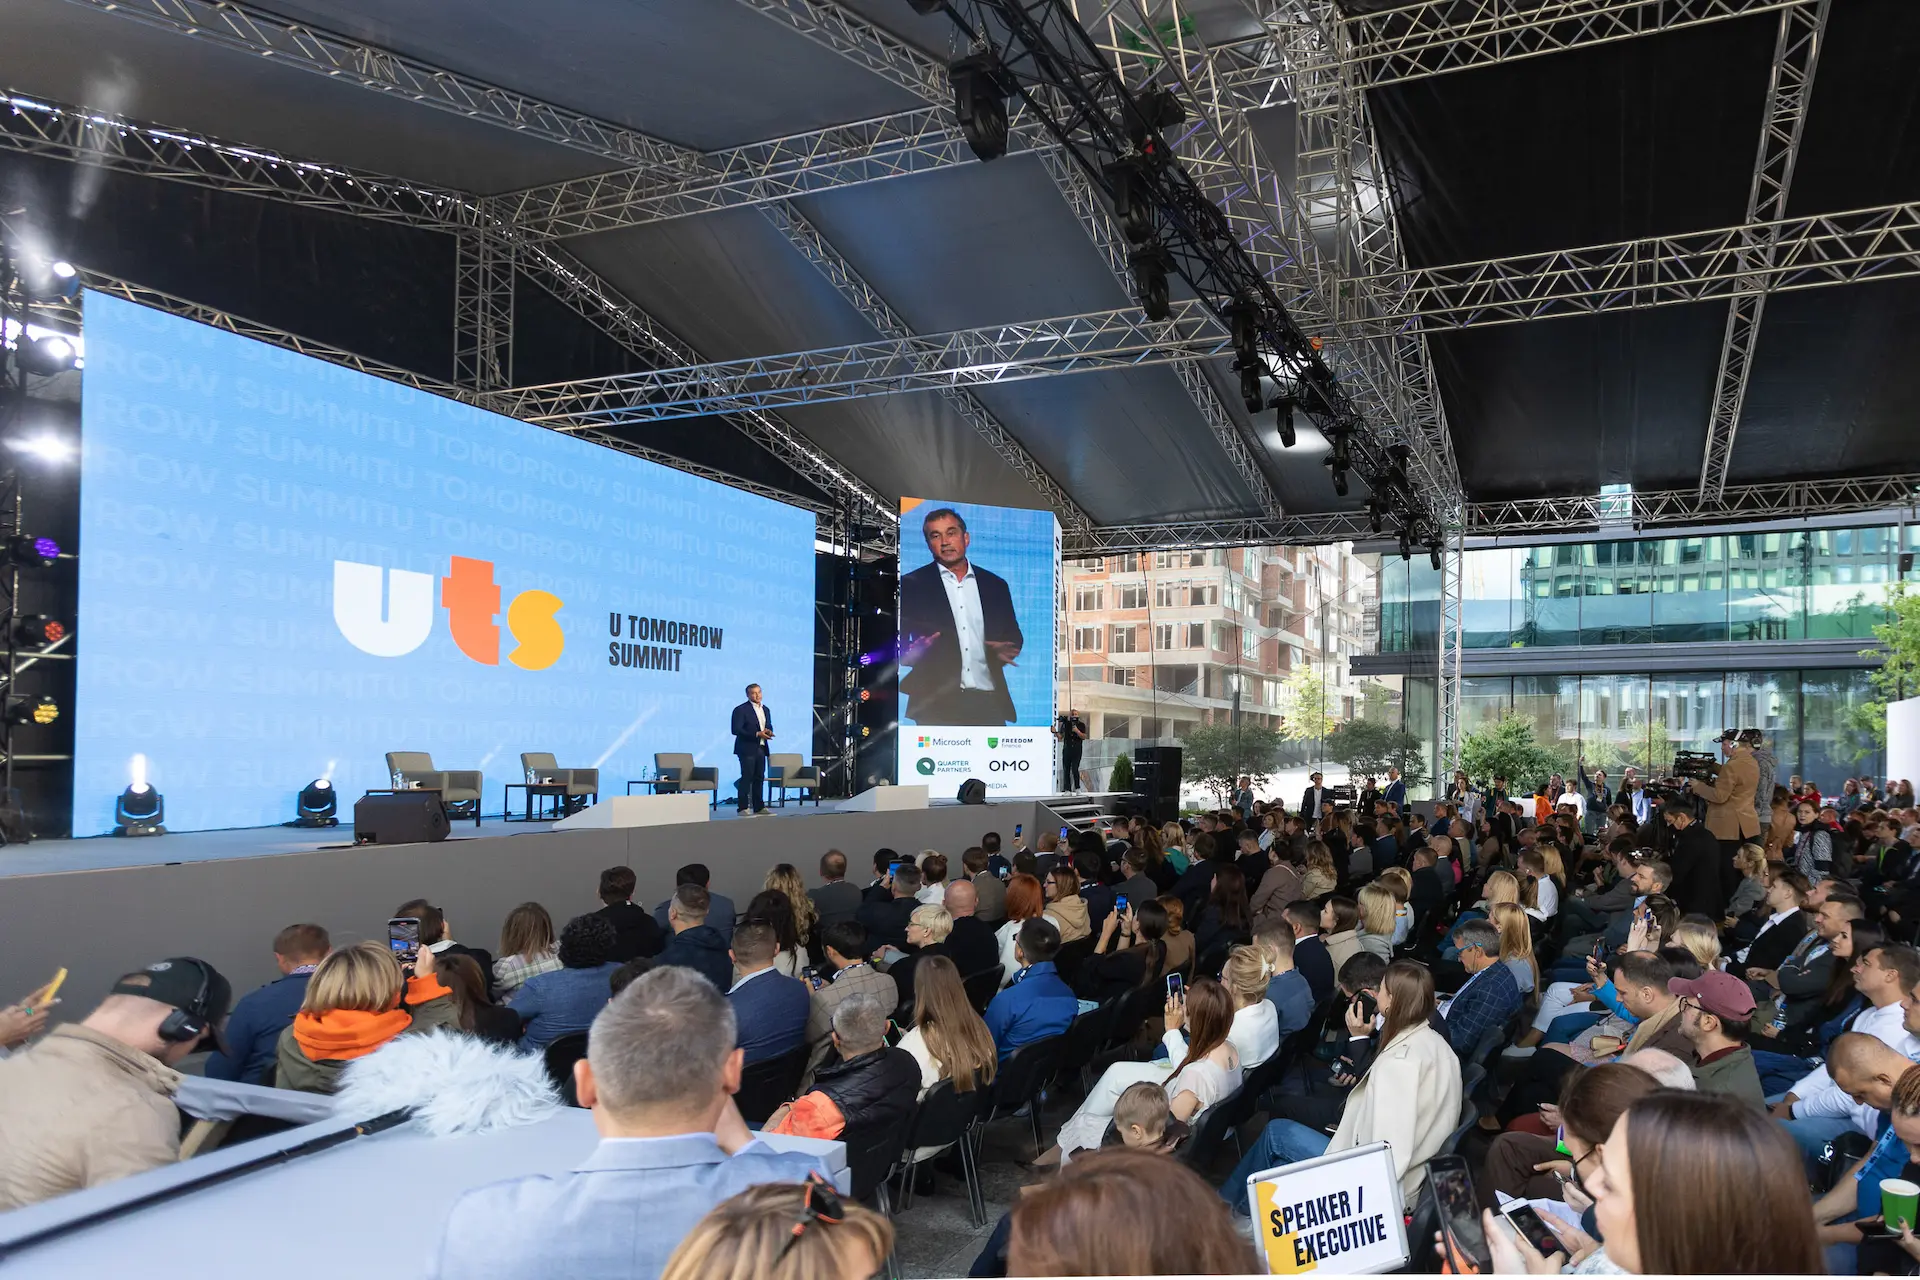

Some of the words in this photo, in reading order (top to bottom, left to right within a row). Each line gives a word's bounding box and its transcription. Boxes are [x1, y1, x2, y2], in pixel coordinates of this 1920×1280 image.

[333, 556, 564, 671] uts
[610, 613, 622, 637] U
[628, 615, 723, 650] TOMORROW
[609, 641, 682, 671] SUMMIT
[932, 738, 972, 746] Microsoft
[989, 760, 1030, 772] OMO
[1270, 1190, 1351, 1238] SPEAKER
[1358, 1185, 1363, 1214] /
[1293, 1213, 1387, 1267] EXECUTIVE
